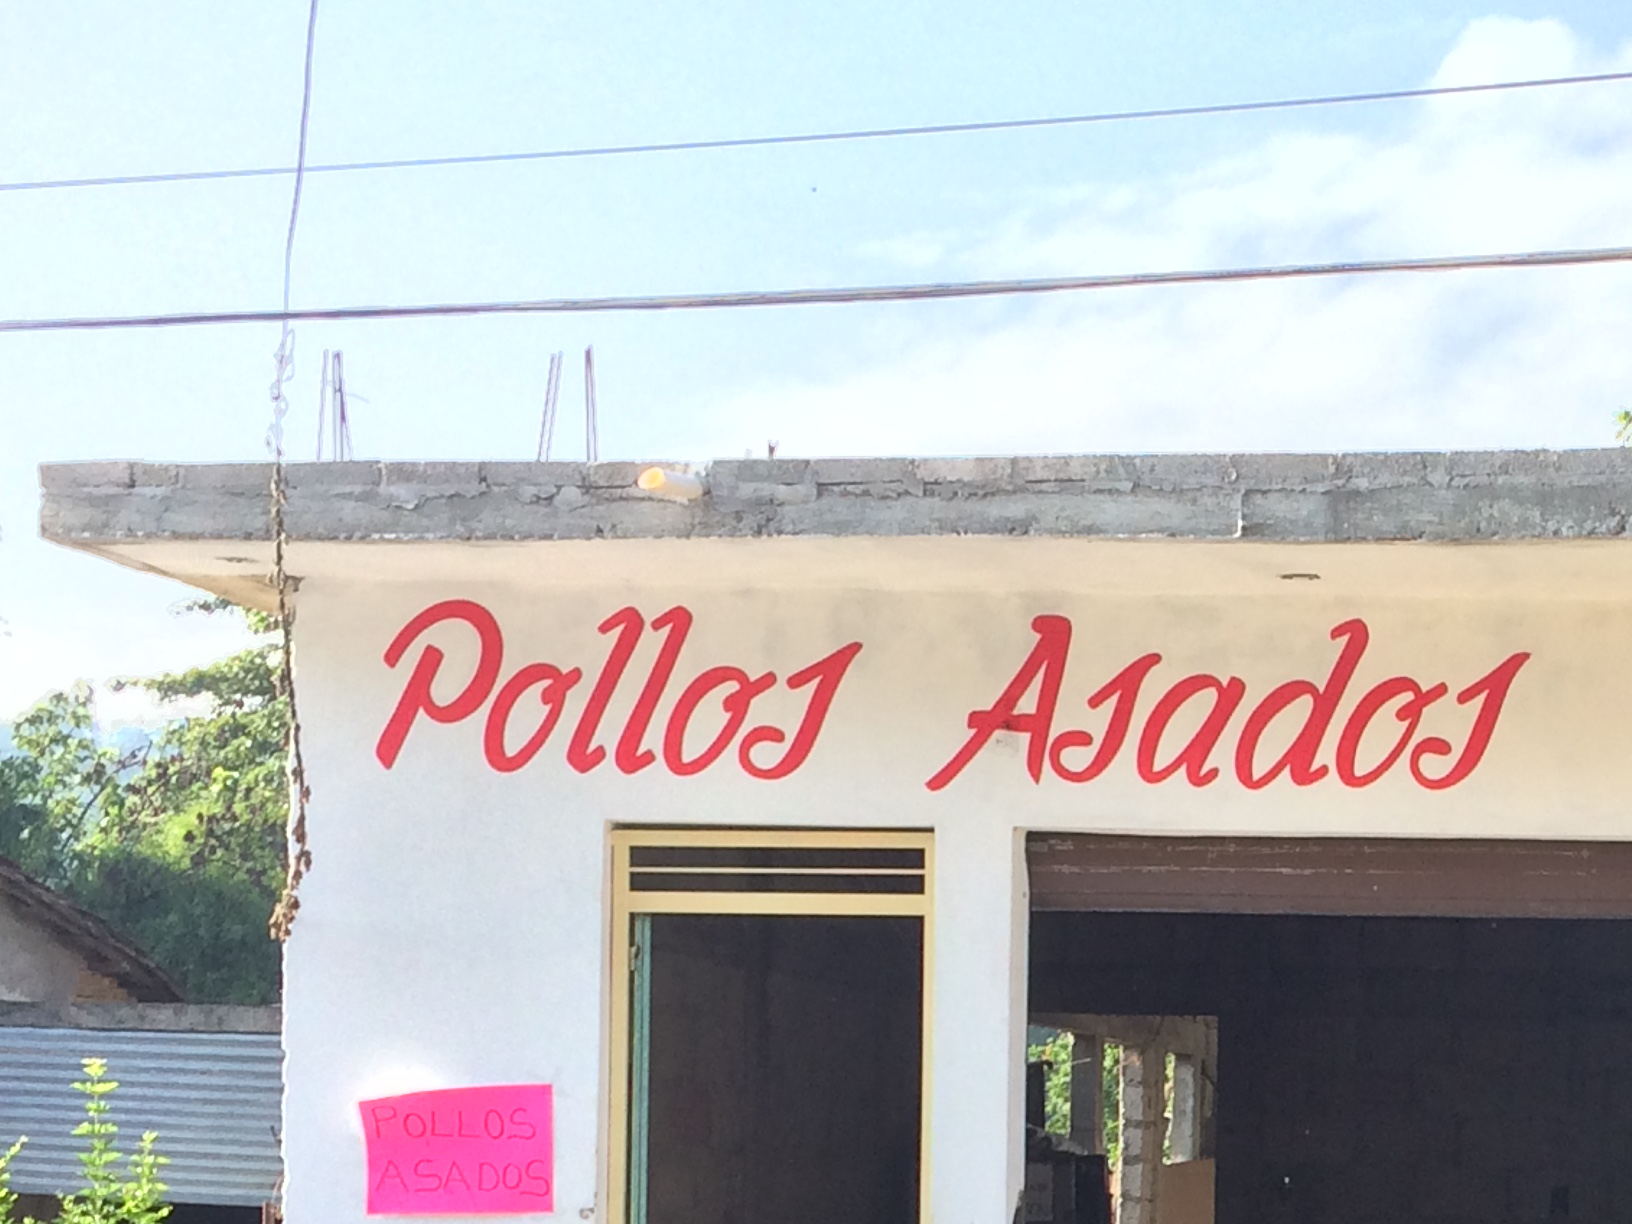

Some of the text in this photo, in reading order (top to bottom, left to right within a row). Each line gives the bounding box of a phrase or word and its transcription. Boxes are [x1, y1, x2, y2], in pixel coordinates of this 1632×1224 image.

[374, 599, 1532, 792] Pollos Asados
[371, 1104, 536, 1141] POLLOS
[374, 1159, 551, 1197] ASADOS
